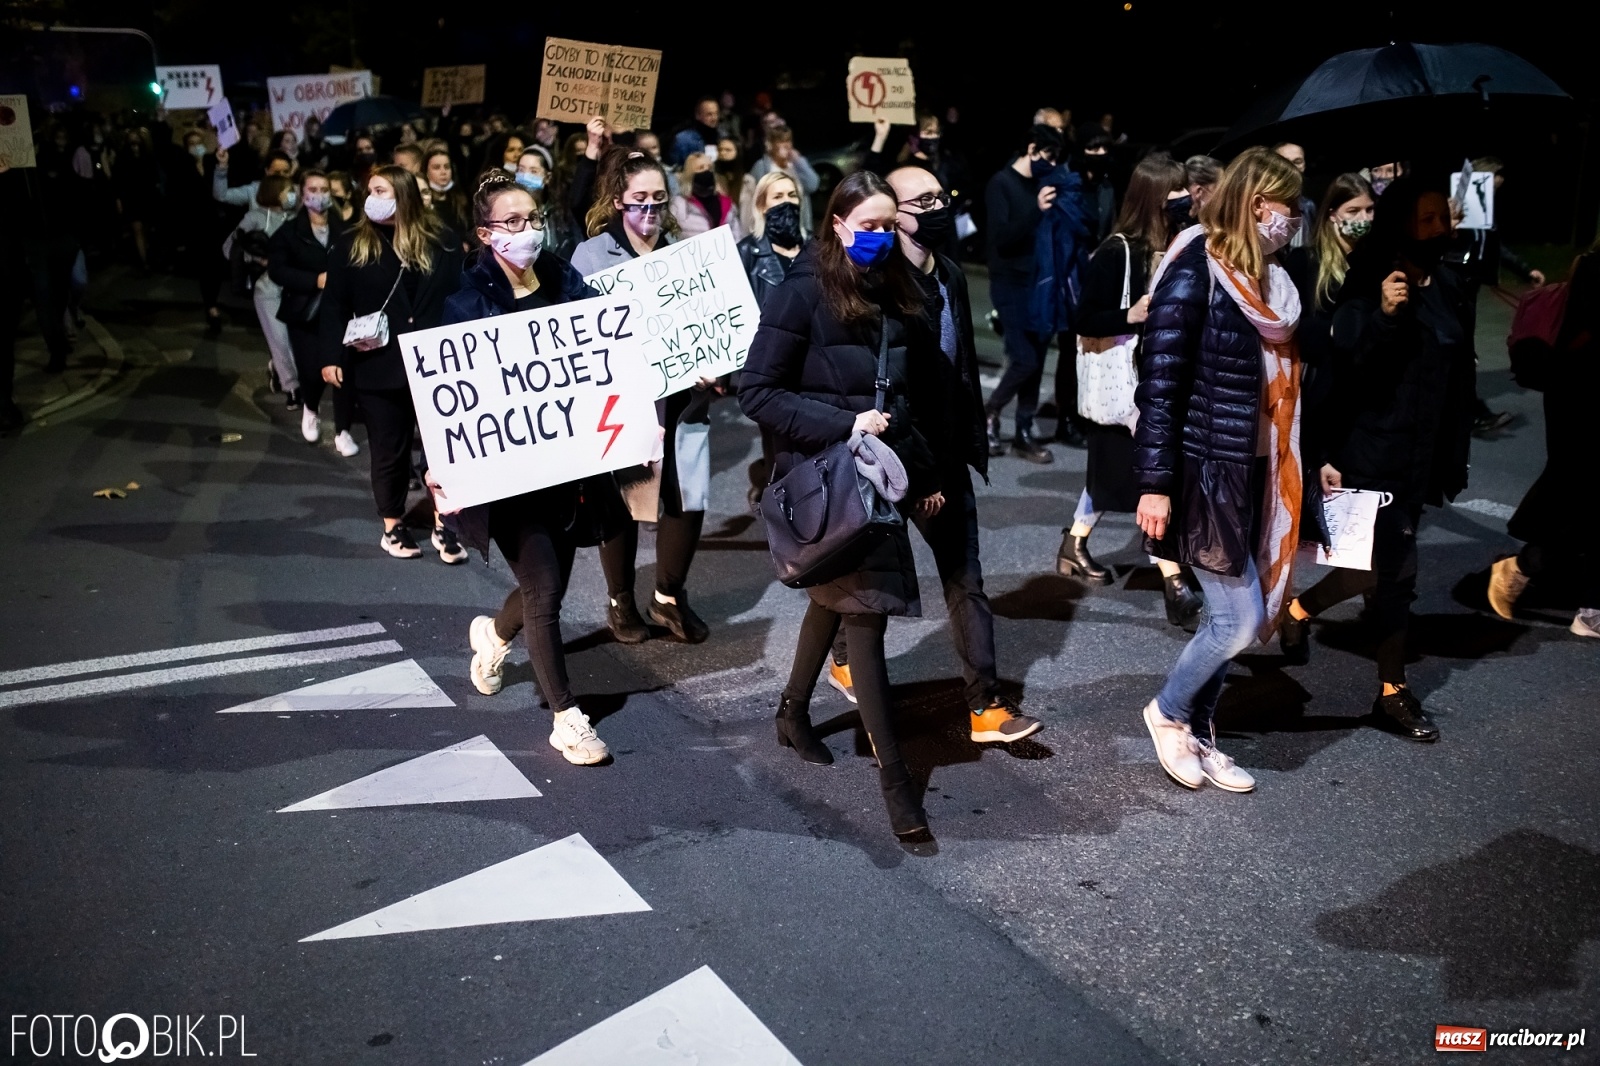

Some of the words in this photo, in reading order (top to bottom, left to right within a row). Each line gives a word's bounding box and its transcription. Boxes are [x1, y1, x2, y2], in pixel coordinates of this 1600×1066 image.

[545, 45, 581, 62] GDYBY
[585, 49, 600, 65] TO
[546, 63, 612, 82] ZACHODZILI
[271, 86, 286, 104] W
[555, 81, 569, 92] TO
[644, 260, 669, 283] OD
[657, 269, 716, 308] SRAM
[413, 327, 502, 378] ŁAPY
[528, 304, 633, 355] PRECZ
[661, 327, 681, 353] W
[432, 380, 479, 417] OD
[501, 348, 613, 396] MOJEJ
[445, 397, 575, 464] MACICY
